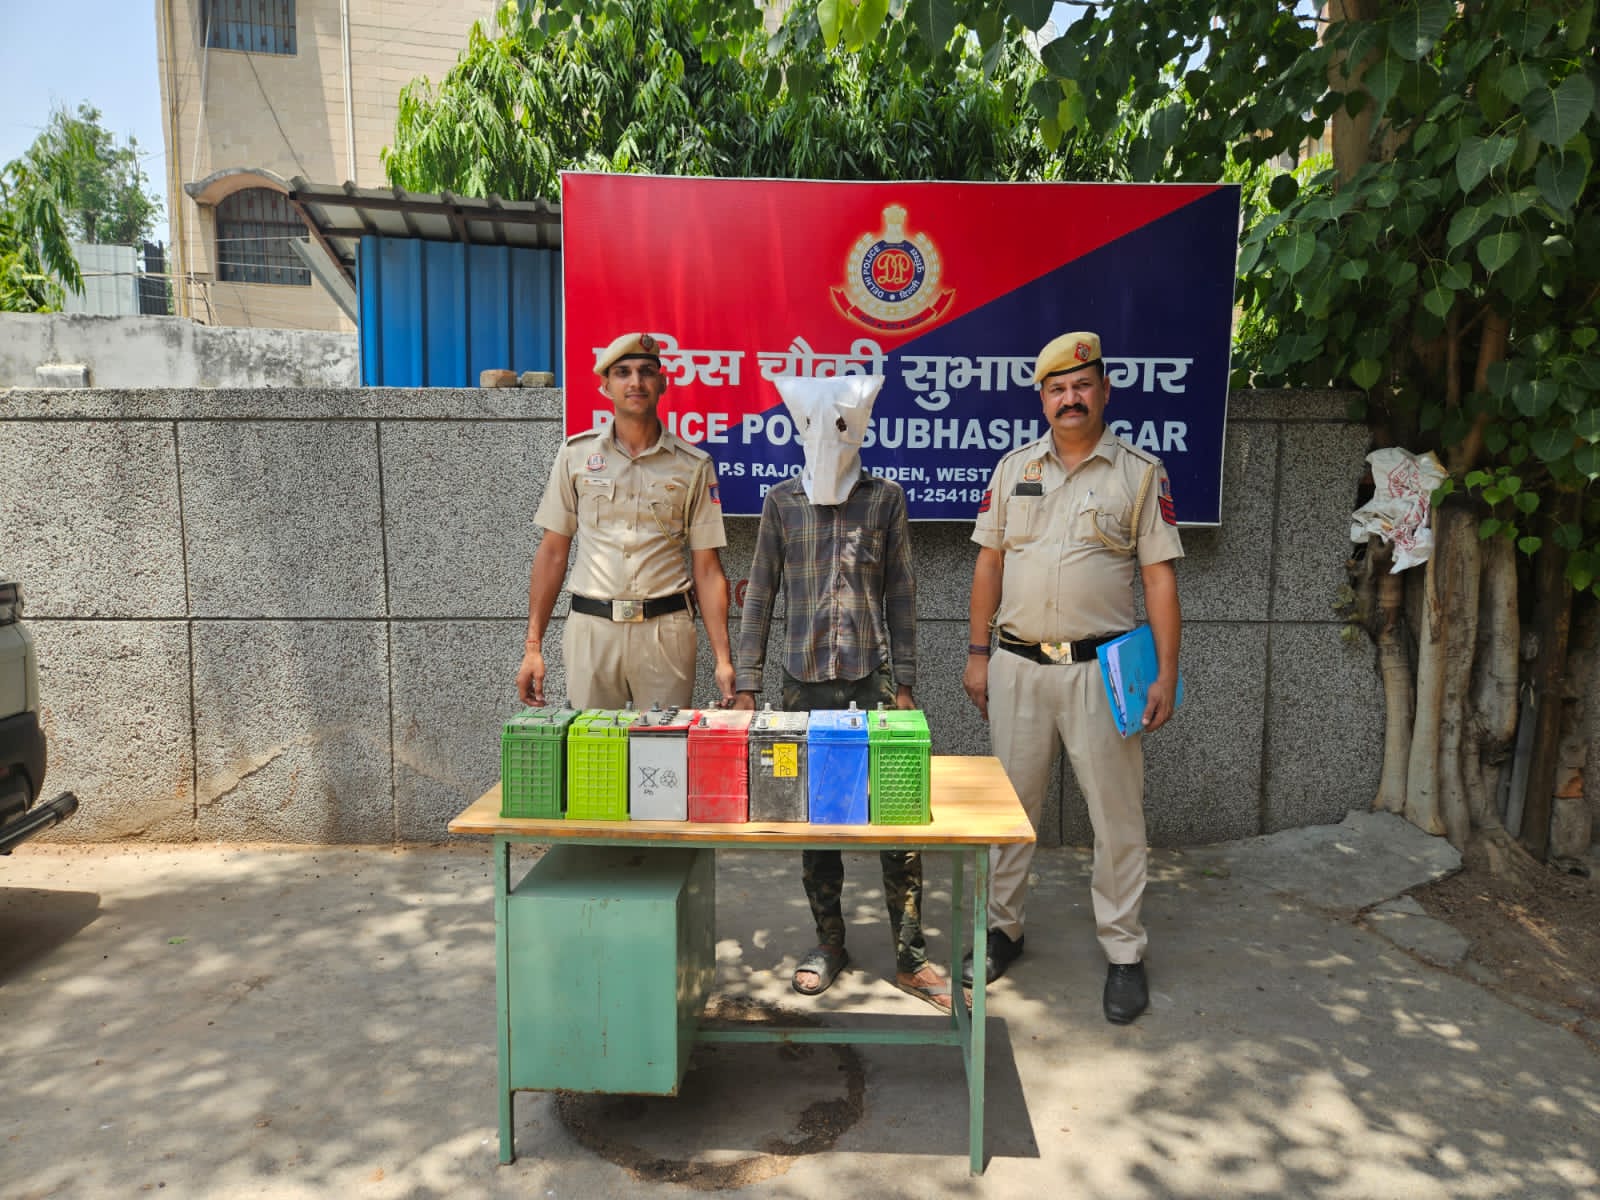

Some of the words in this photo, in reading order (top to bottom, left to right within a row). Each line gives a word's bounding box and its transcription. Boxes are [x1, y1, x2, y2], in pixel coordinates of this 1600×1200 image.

[863, 245, 880, 275] POLICE
[864, 275, 885, 298] DELHI
[1102, 357, 1193, 393] गर
[592, 410, 729, 444] PICE
[742, 413, 804, 446] PO
[1109, 420, 1188, 452] GAR
[718, 462, 745, 477] P.S
[751, 463, 804, 478] RAJO
[863, 466, 930, 483] RDEN,
[936, 468, 991, 482] WEST
